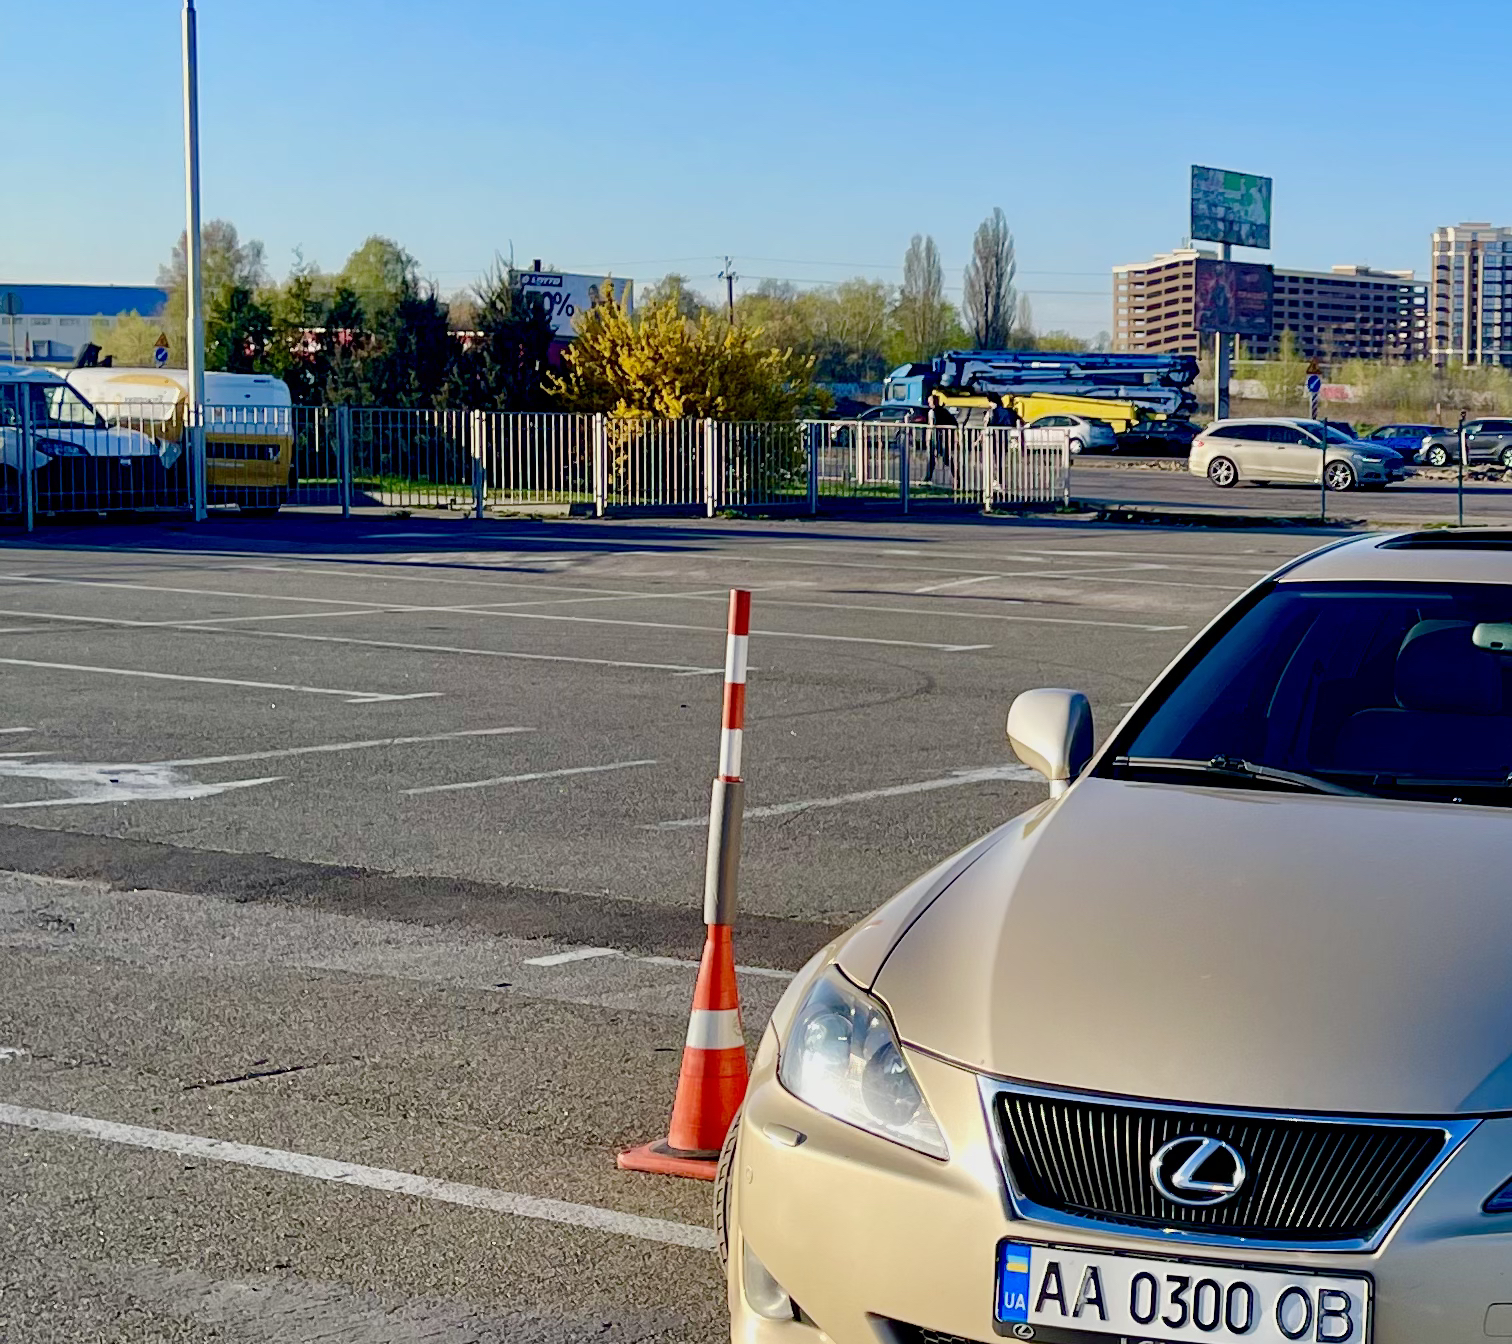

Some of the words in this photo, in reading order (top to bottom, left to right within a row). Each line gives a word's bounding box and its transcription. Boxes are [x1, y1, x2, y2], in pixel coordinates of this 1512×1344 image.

[1004, 1291, 1027, 1311] UA
[1034, 1260, 1108, 1321] AA
[1129, 1270, 1256, 1336] 0300
[1275, 1285, 1354, 1344] OB
